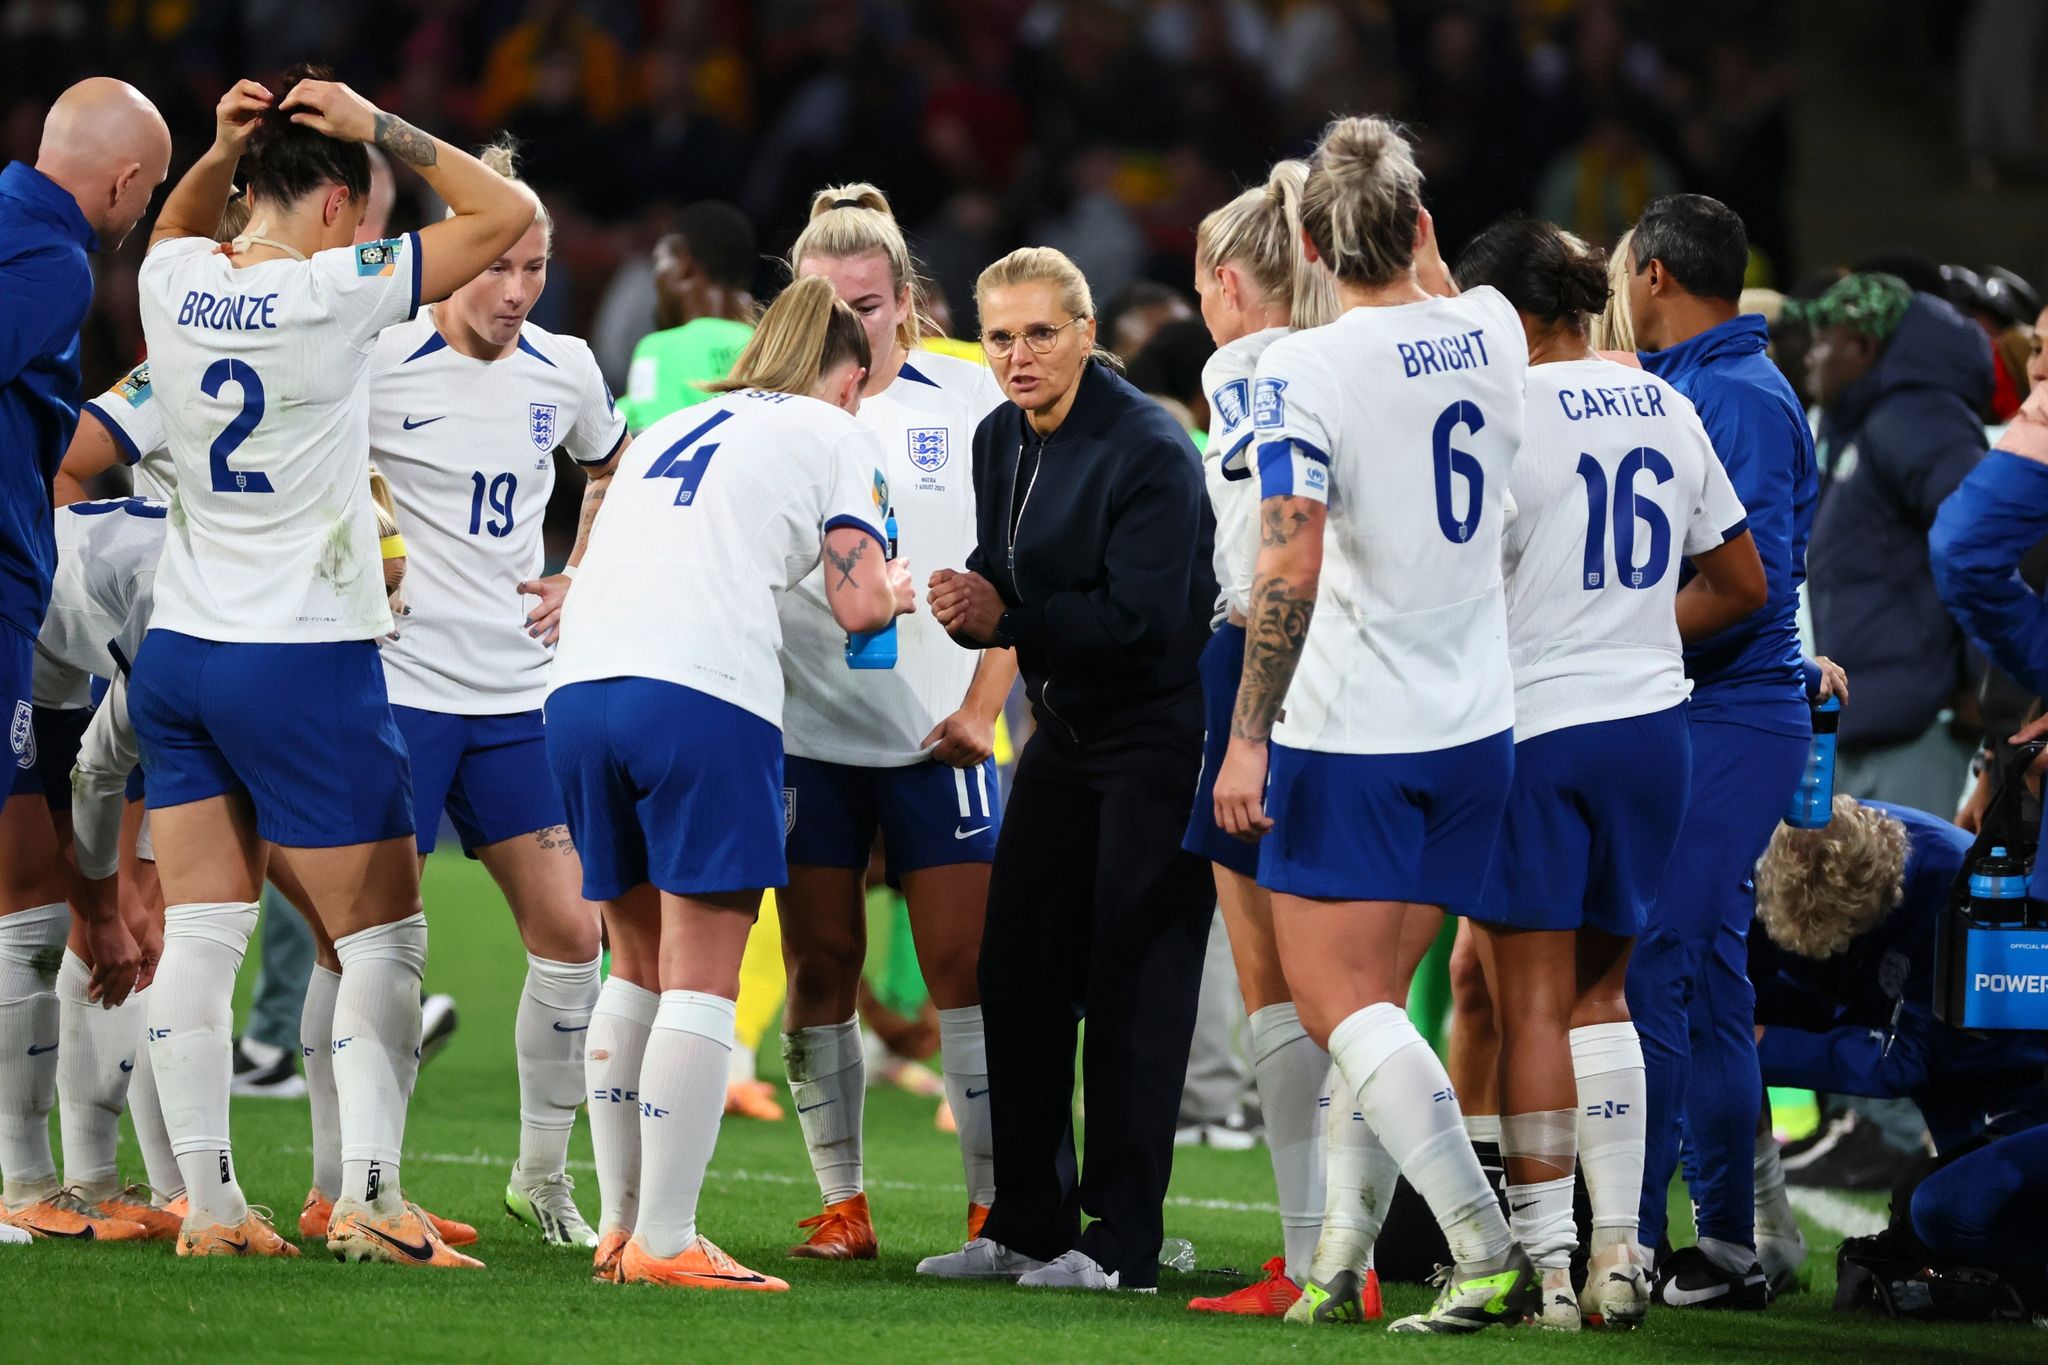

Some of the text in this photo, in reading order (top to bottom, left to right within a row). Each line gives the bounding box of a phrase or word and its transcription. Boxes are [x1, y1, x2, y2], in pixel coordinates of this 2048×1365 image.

[177, 290, 279, 330] BRONZE
[1397, 329, 1490, 378] BRIGHT
[200, 357, 276, 494] 2
[1558, 384, 1667, 421] CARTER
[641, 408, 735, 507] 4
[1432, 399, 1486, 544] 6
[468, 470, 518, 538] 19
[1575, 446, 1675, 591] 16
[952, 763, 991, 818] 11
[1975, 973, 2048, 993] POWER
